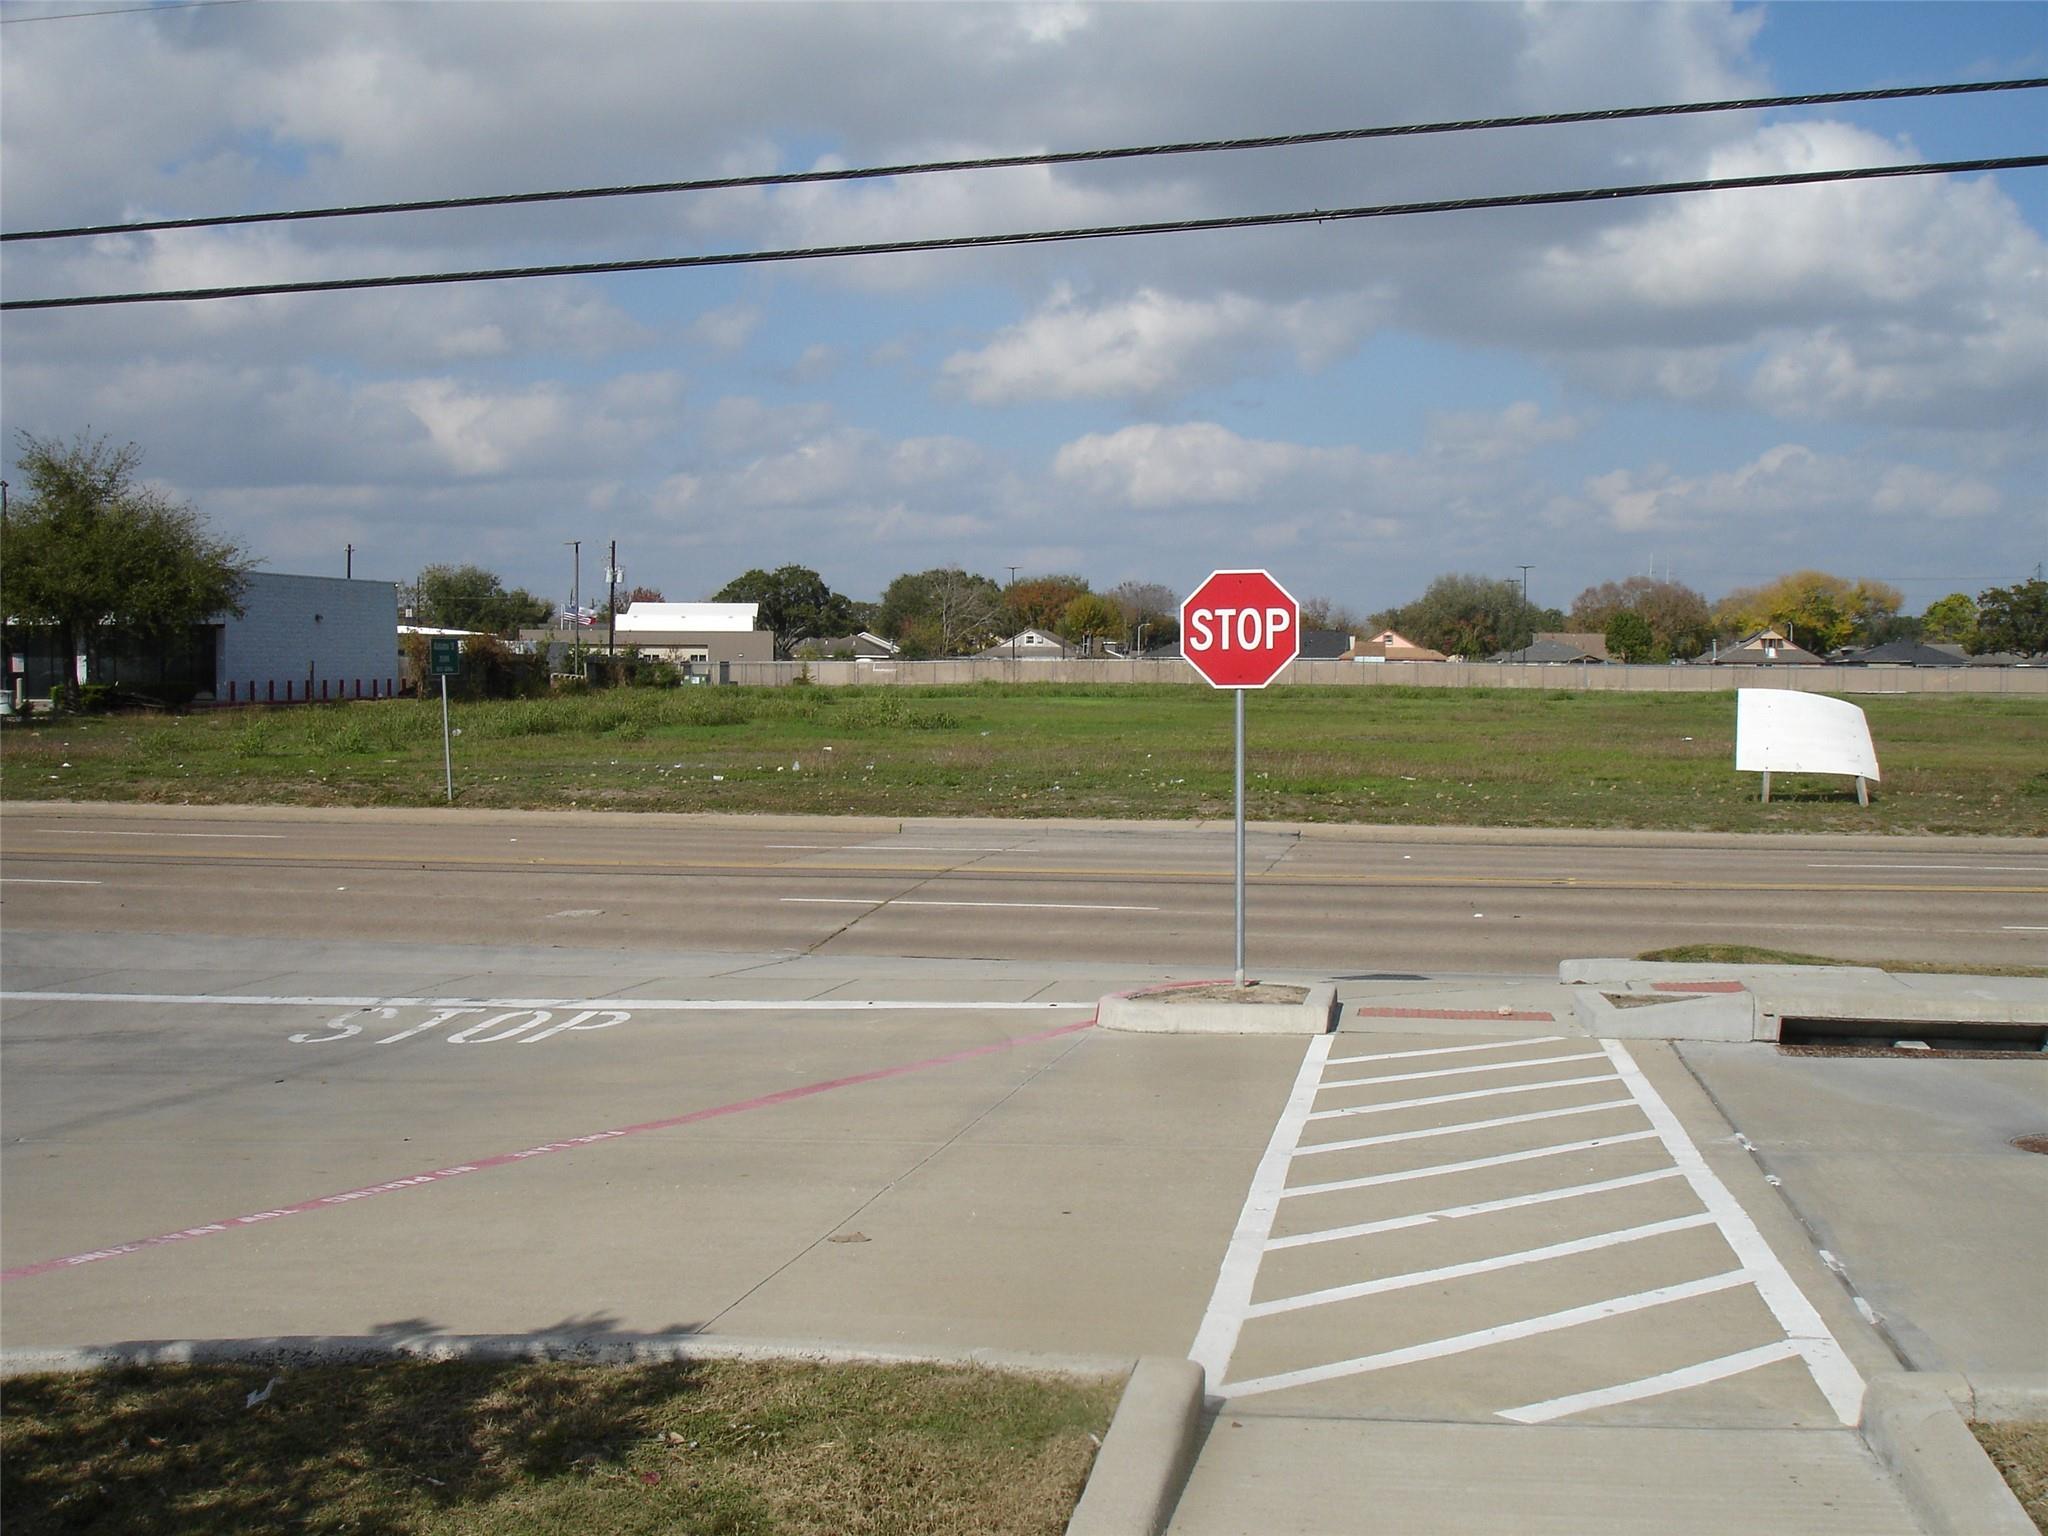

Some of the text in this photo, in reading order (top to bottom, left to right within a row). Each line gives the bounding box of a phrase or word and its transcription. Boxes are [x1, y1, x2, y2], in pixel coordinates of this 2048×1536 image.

[1189, 607, 1291, 651] STOP
[287, 1006, 632, 1044] STOP
[435, 1165, 479, 1176] NO
